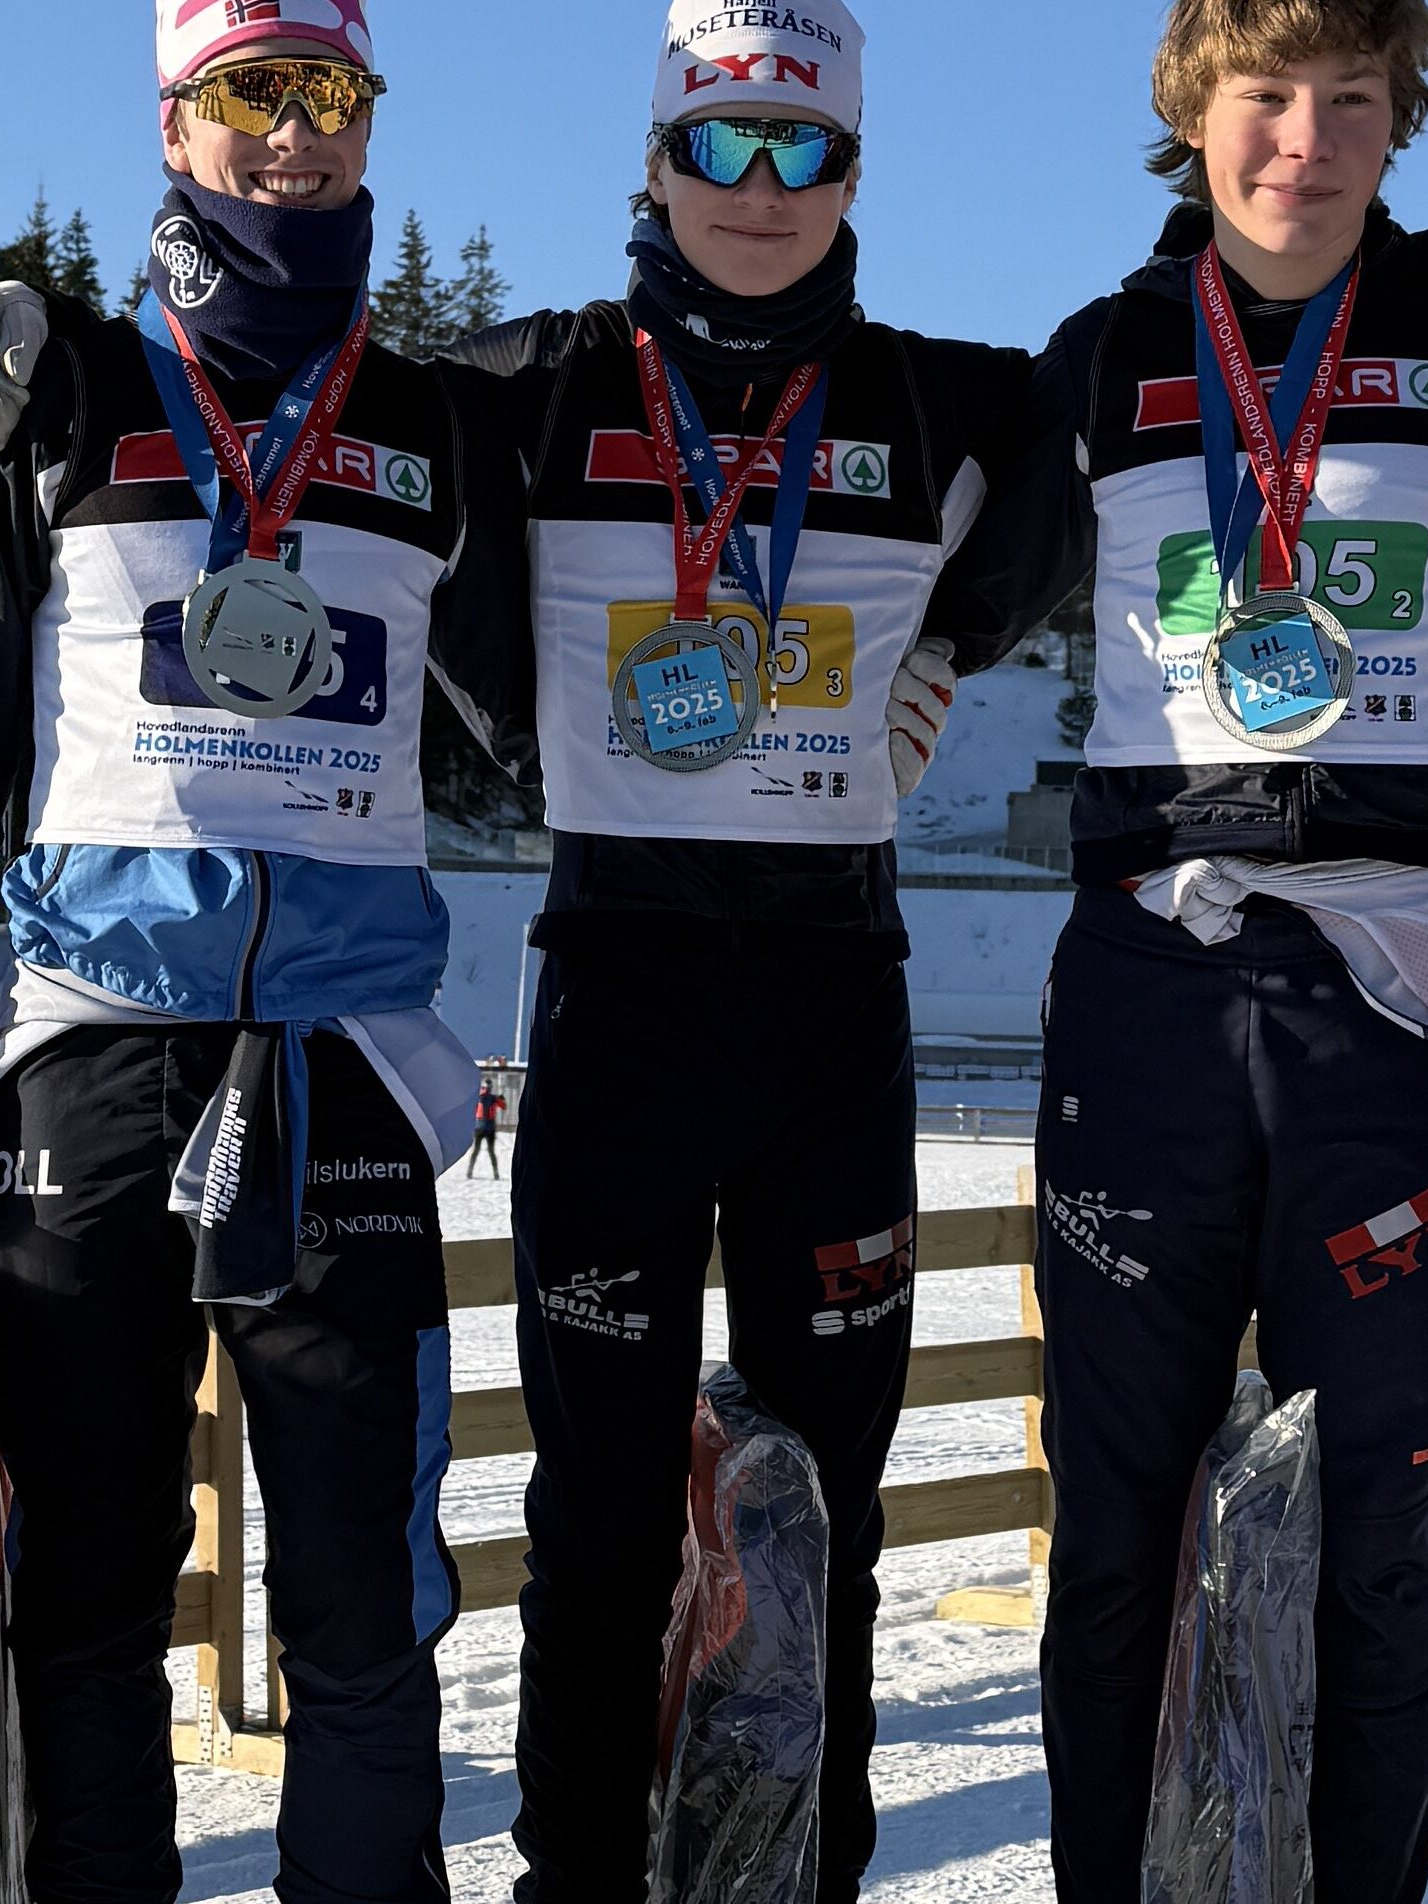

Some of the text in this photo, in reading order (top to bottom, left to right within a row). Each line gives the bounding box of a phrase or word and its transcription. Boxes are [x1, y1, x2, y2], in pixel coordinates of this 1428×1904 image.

[684, 53, 820, 95] LYN
[324, 368, 348, 414] HOPP
[1313, 351, 1334, 399] HOPP
[653, 401, 673, 448] HOPP
[270, 428, 321, 519] KOMBINERT
[1282, 422, 1318, 526] KOMBINERT
[1390, 589, 1414, 619] 2
[1249, 635, 1290, 661] HL
[661, 663, 699, 687] HL
[825, 667, 844, 698] 3
[1241, 657, 1318, 704] 2025
[1355, 655, 1417, 677] 2025
[359, 685, 378, 713] 4
[651, 688, 724, 726] 2025
[136, 720, 247, 738] Hovedlandsrenn
[795, 732, 852, 756] 2025
[133, 753, 185, 766] langrenn
[197, 755, 230, 771] hopp
[240, 760, 301, 777] kombinert
[134, 731, 382, 775] HOLMENKOLLEN 2025
[306, 1156, 411, 1185] ilslukern
[335, 1214, 424, 1235] NORDVIK
[1054, 1200, 1115, 1264] BULL
[820, 1242, 912, 1303] LYN
[1060, 1228, 1109, 1275] KAJAKK
[1110, 1273, 1133, 1288] AS
[548, 1294, 622, 1327] BULL
[850, 1281, 911, 1327] sport
[563, 1315, 619, 1337] KAJAKK
[622, 1331, 642, 1341] AS
